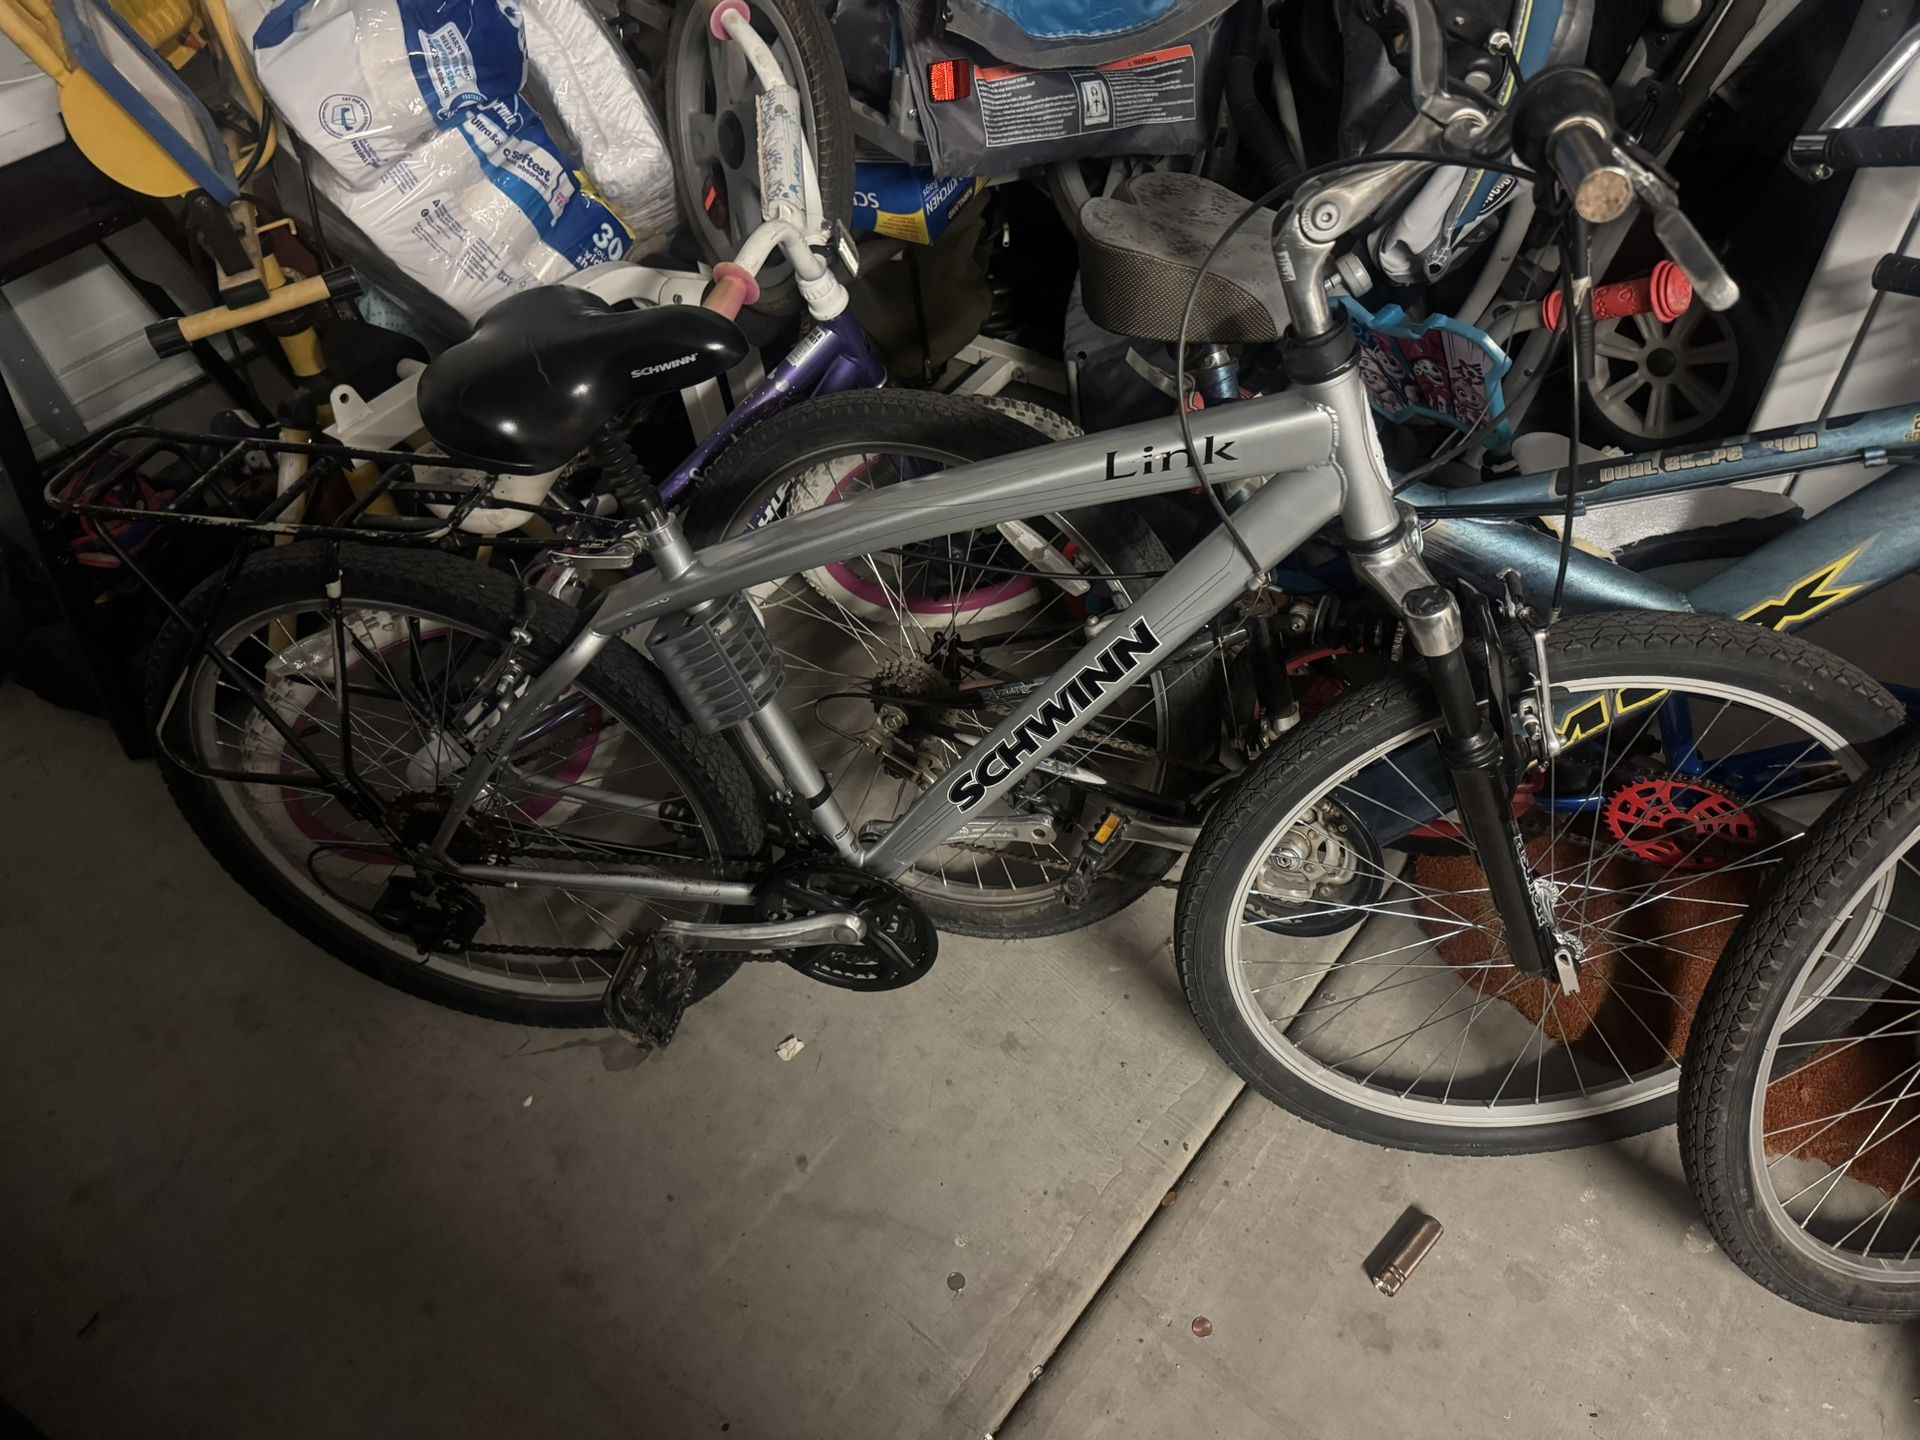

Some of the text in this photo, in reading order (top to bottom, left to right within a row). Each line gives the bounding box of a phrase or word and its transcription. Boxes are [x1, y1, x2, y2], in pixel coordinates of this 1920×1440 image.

[470, 115, 492, 137] Ultra
[511, 149, 552, 181] softest
[925, 177, 959, 216] KITCHEN
[592, 222, 623, 261] 30
[630, 352, 698, 379] SCHWINN
[1103, 435, 1239, 481] Link
[1599, 461, 1659, 483] DUAL
[946, 614, 1163, 814] SCHWINN
